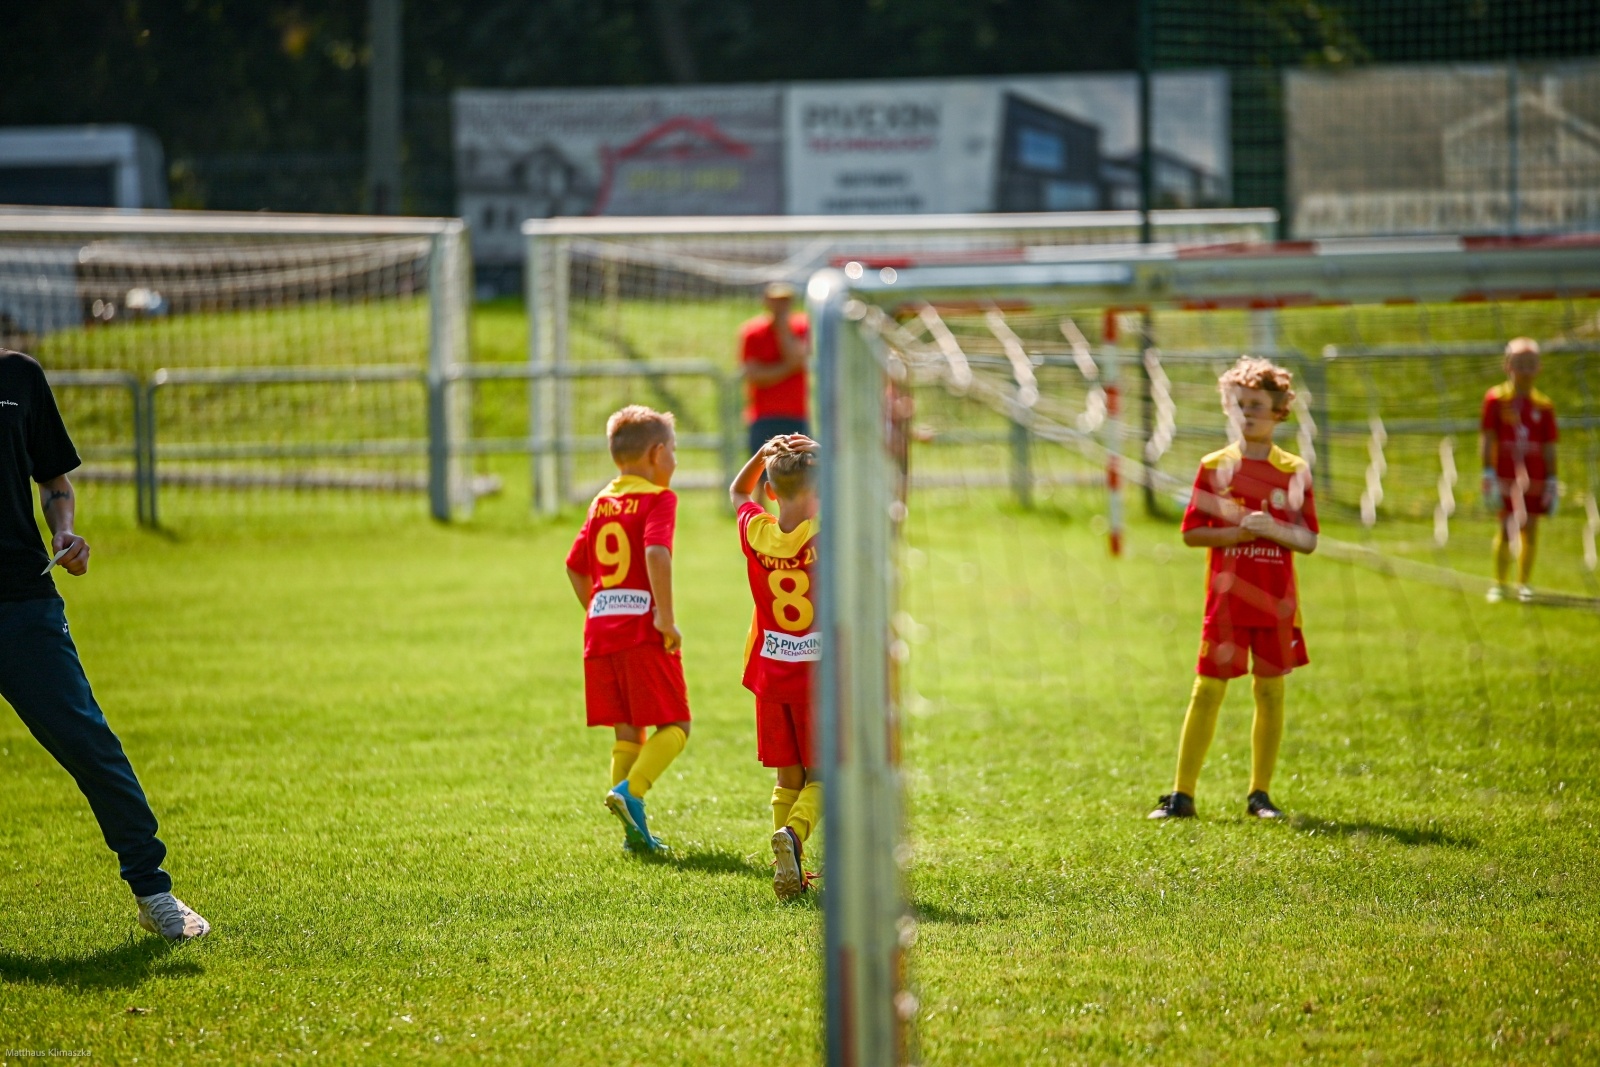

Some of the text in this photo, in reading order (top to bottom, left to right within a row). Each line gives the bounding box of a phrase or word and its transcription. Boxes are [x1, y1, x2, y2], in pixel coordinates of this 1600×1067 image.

[624, 498, 639, 514] 21
[595, 521, 631, 588] 9
[803, 545, 818, 565] 21
[608, 594, 648, 605] PIVEXIN
[767, 568, 814, 631] 8
[780, 638, 820, 651] PIVEXIN
